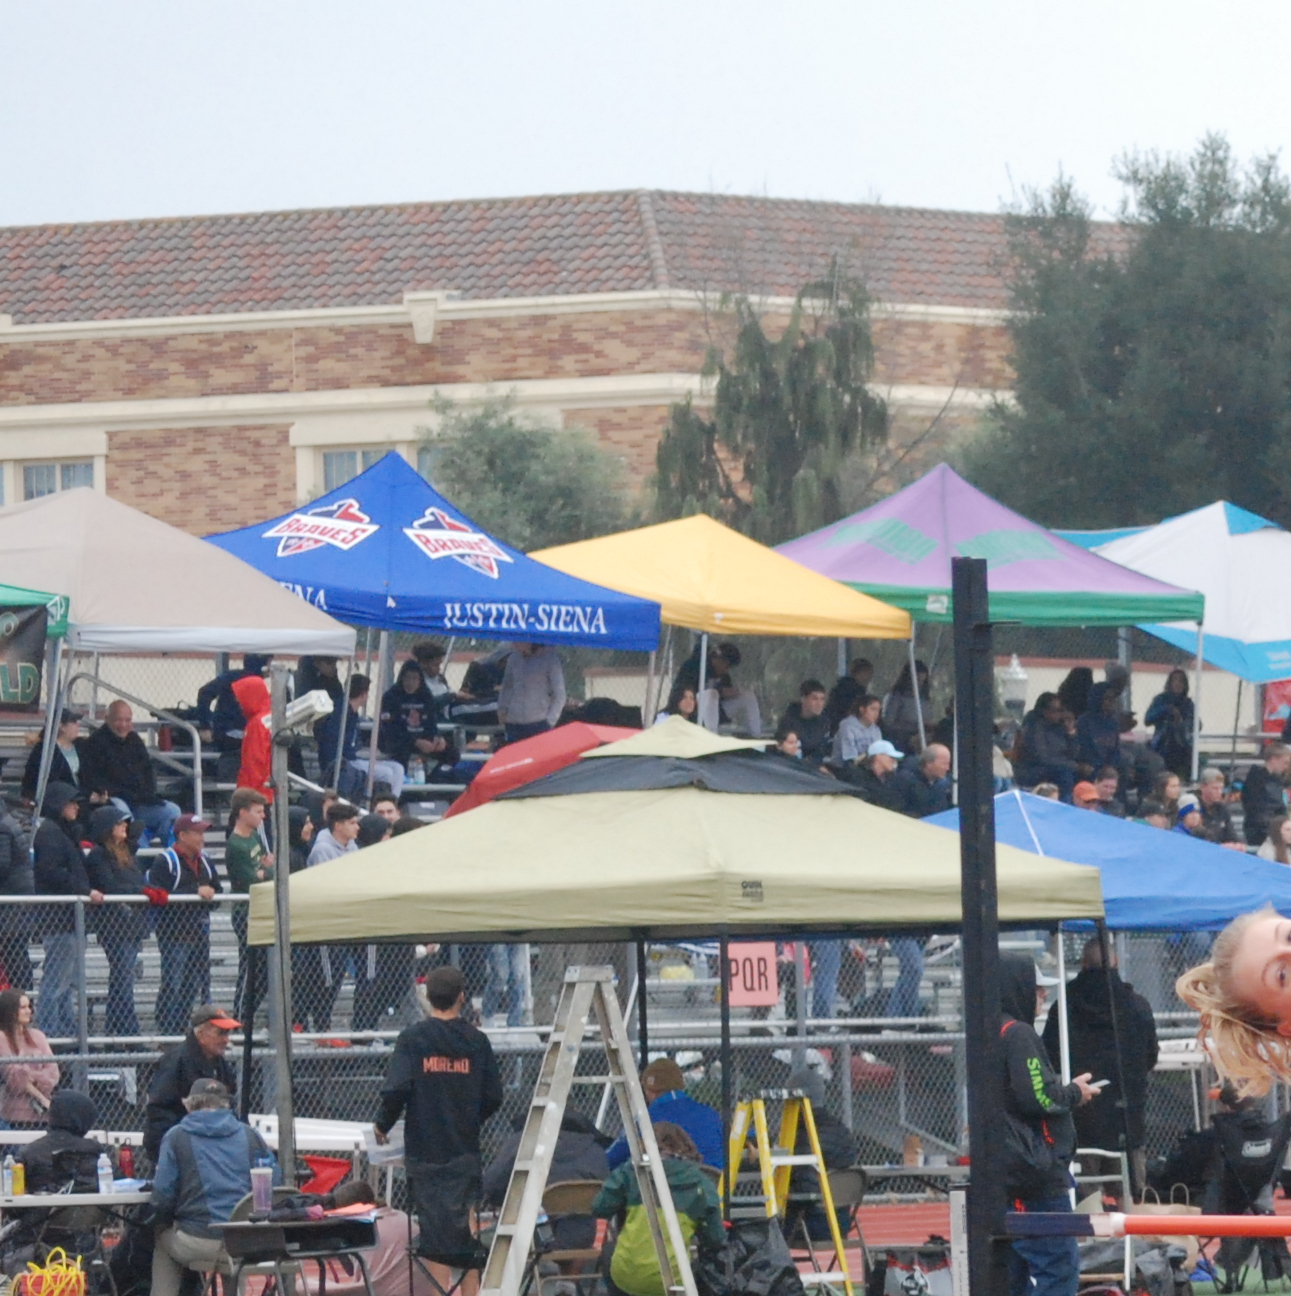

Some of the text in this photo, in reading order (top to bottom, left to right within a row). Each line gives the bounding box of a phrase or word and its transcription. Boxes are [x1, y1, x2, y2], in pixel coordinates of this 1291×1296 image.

[274, 518, 369, 543] BRAVES
[415, 533, 503, 556] BRAVES
[444, 603, 608, 634] JUSTIN-SIENA
[728, 957, 769, 991] PQR
[423, 1056, 470, 1074] MORENO
